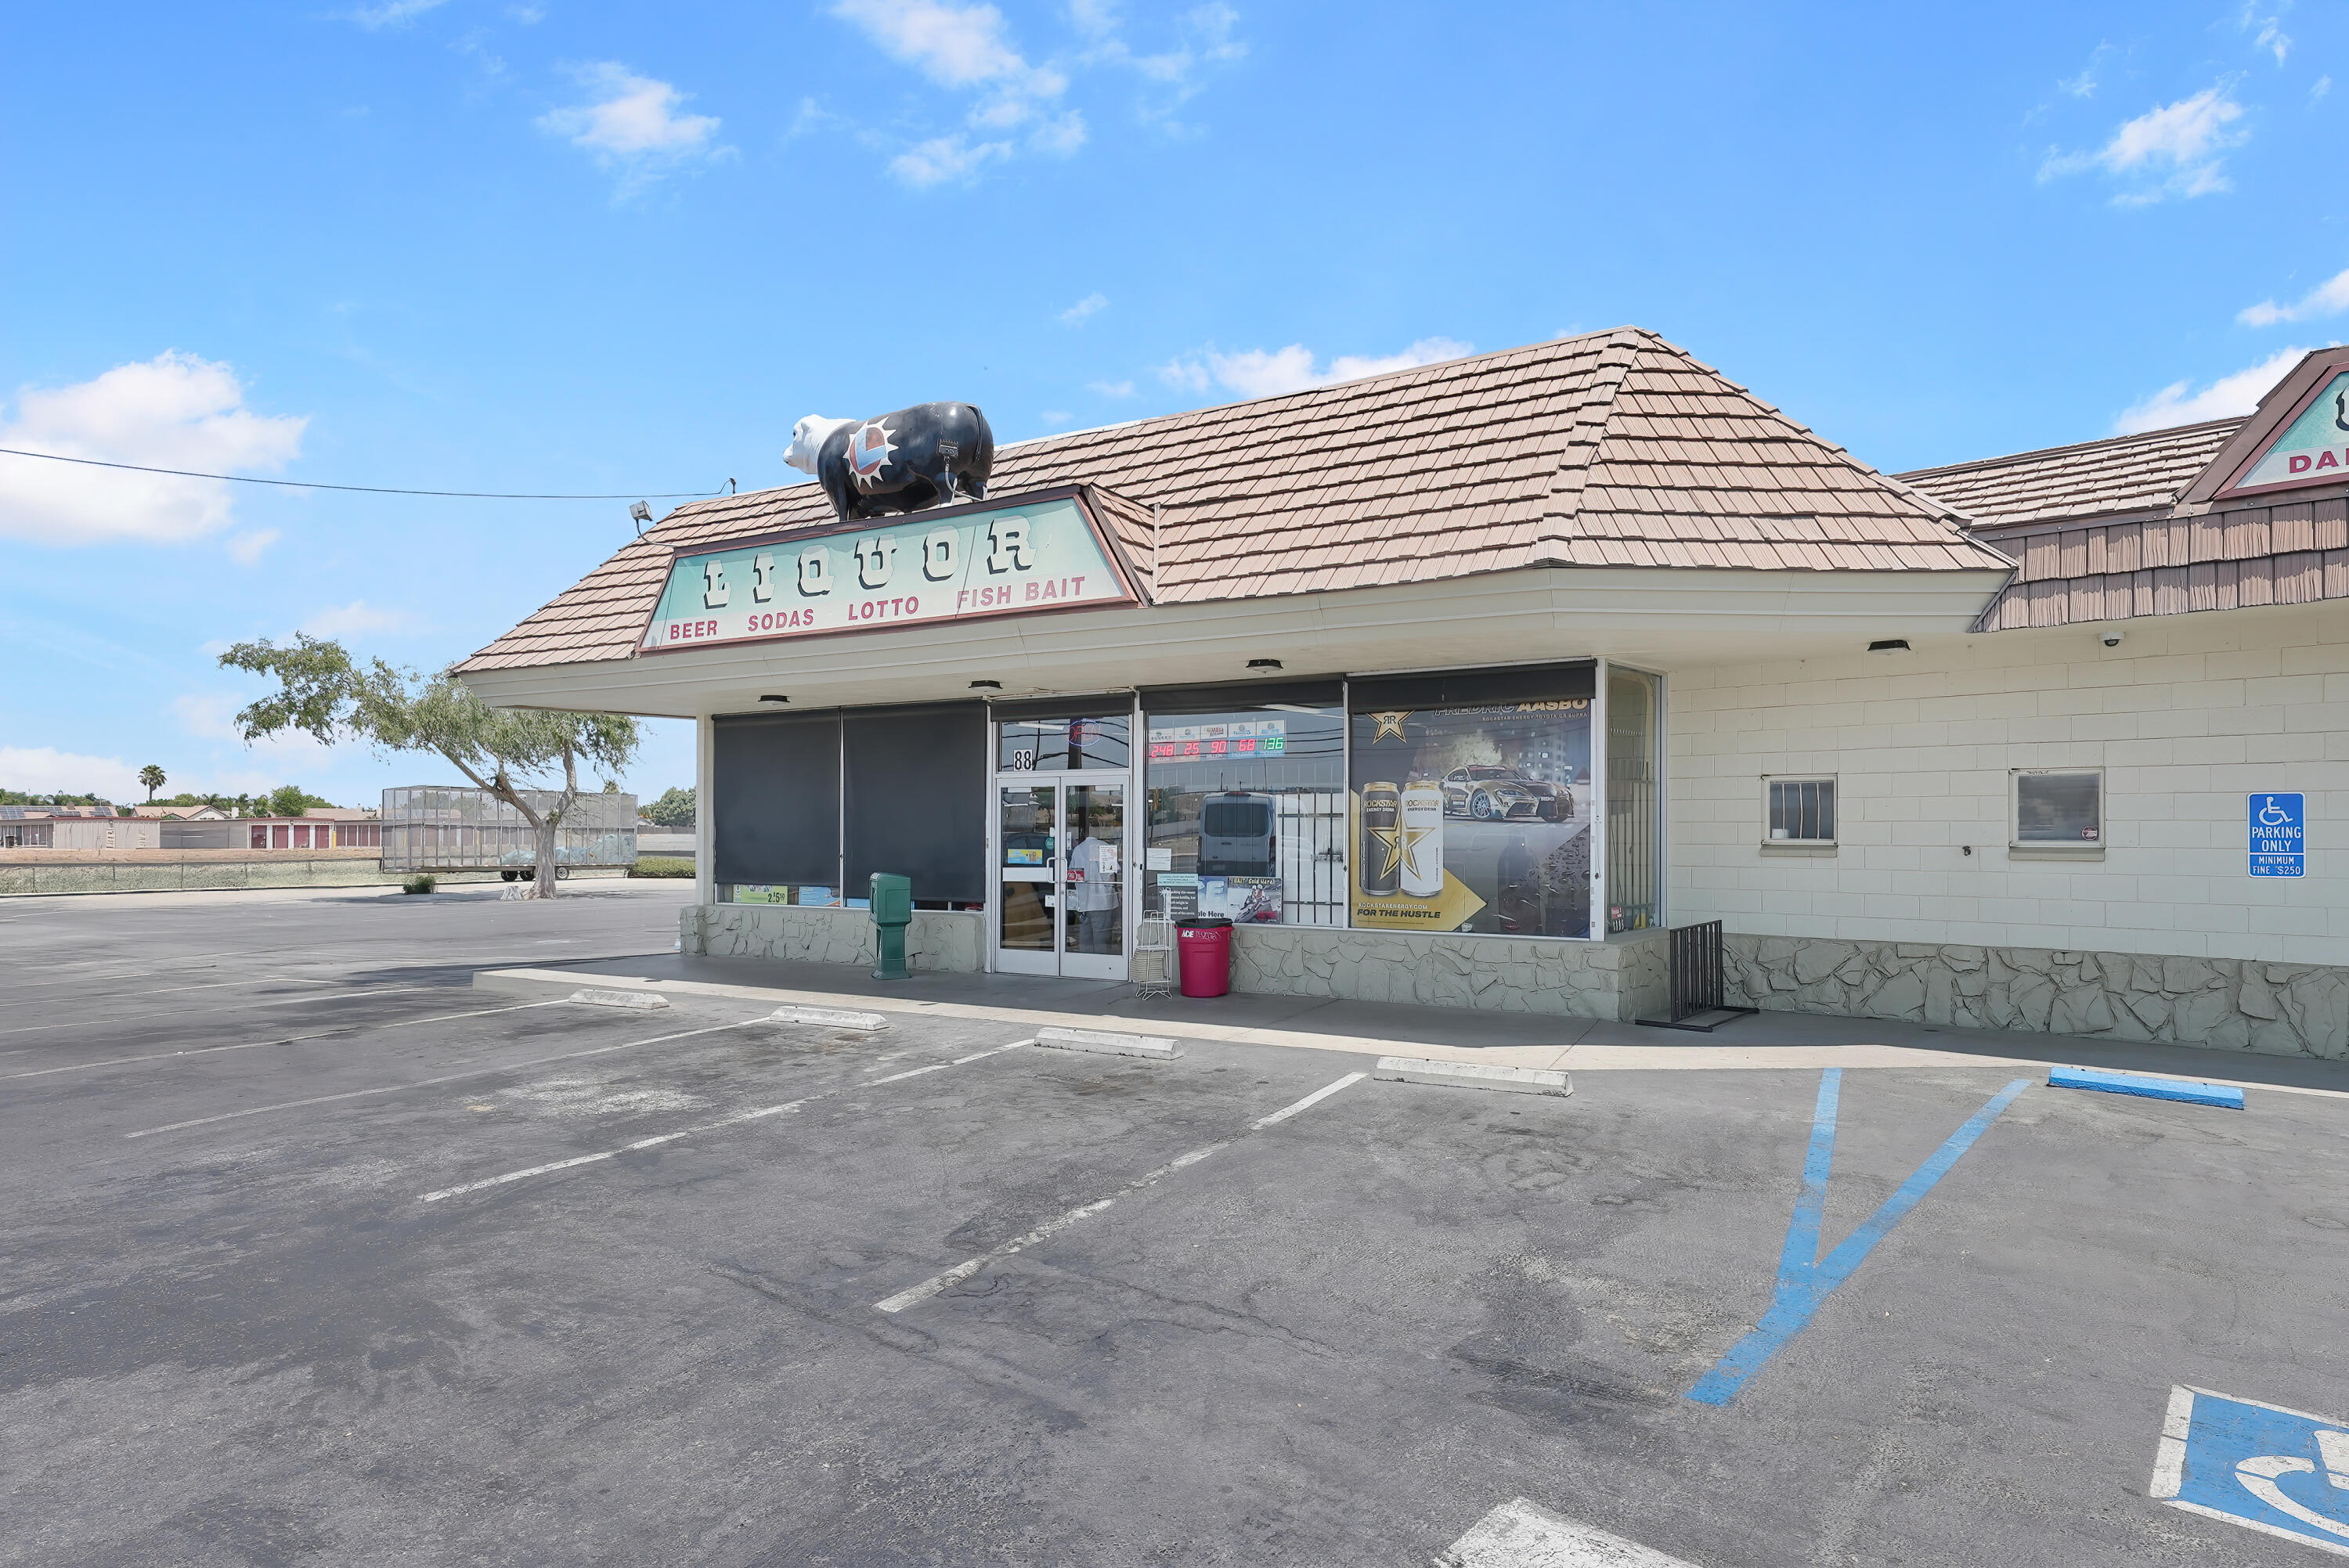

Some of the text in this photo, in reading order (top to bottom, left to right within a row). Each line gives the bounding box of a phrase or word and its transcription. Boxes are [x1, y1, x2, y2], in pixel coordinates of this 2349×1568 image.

[704, 515, 1037, 609] LIQUOR
[670, 576, 1085, 640] BEER SODAS LOTTO FISH BAIT
[1517, 698, 1589, 712] AASBO
[1184, 742, 1200, 755] 25
[1211, 741, 1228, 753] 90
[1239, 739, 1256, 752] 68
[1263, 737, 1283, 750] 136
[1151, 744, 1174, 758] 248
[1014, 750, 1031, 770] 88
[1363, 799, 1397, 808] ROCKSTAR
[2252, 827, 2301, 838] PARKING
[2261, 840, 2292, 852] ONLY
[2258, 856, 2294, 864] MINIMUM
[2253, 866, 2300, 875] FINE $250
[1182, 929, 1195, 938] ACE
